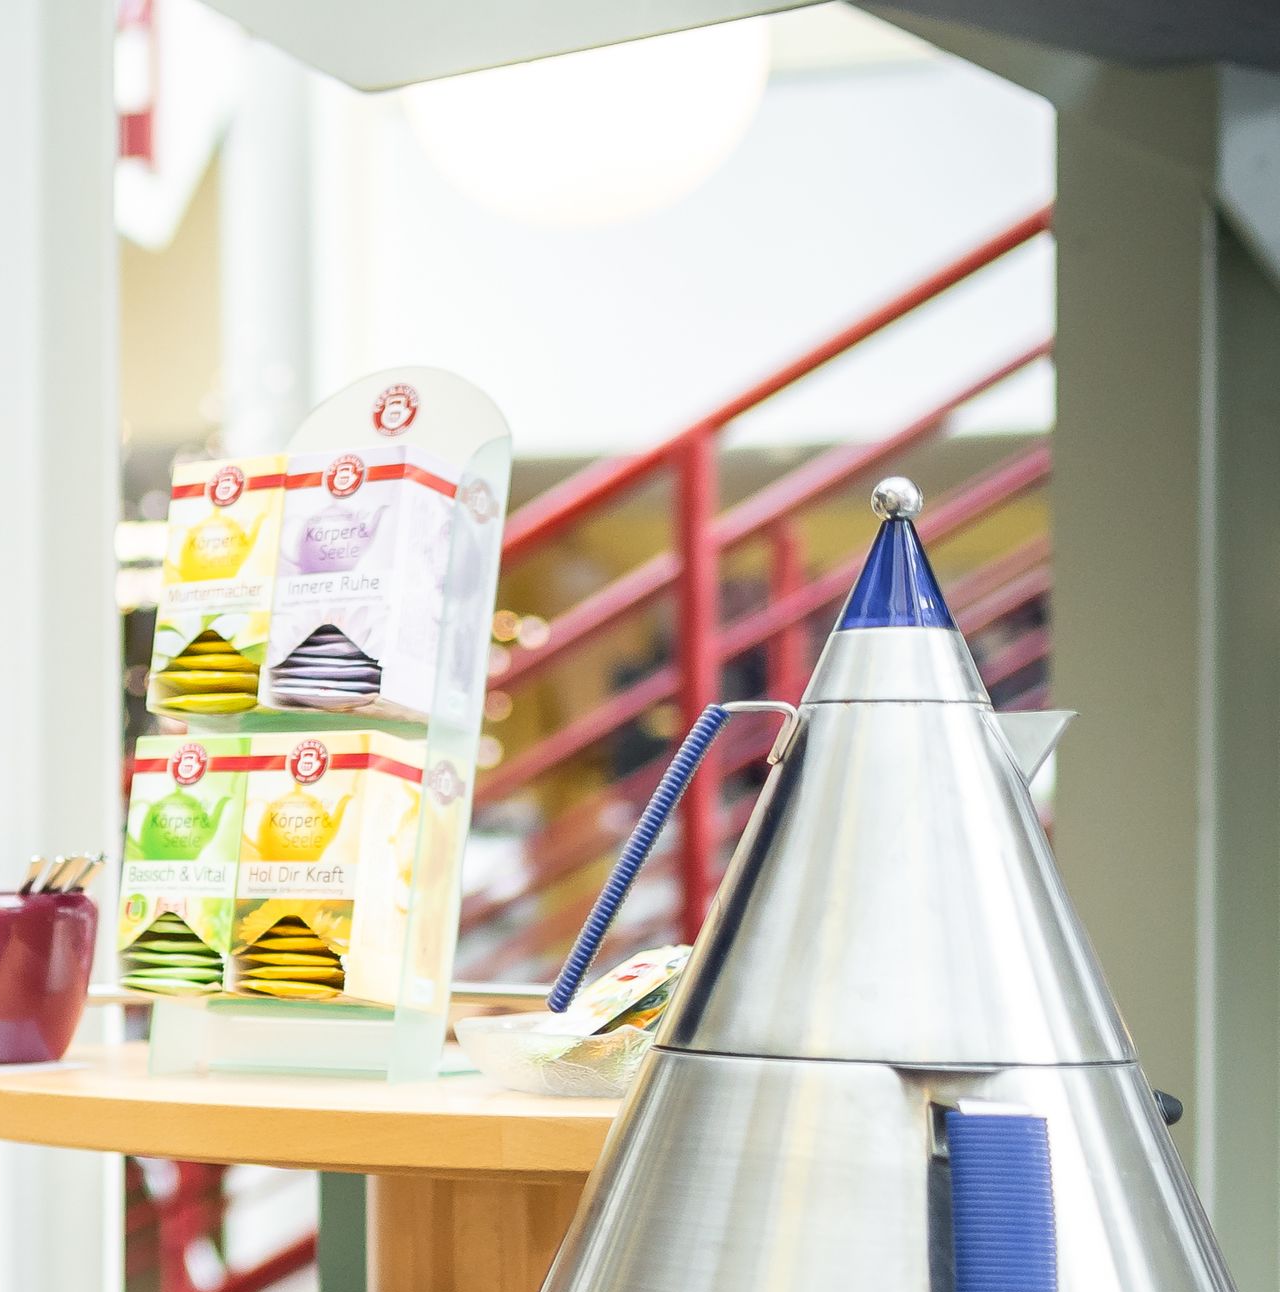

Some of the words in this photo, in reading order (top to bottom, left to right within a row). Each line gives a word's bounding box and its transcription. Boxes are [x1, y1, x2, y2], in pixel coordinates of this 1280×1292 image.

[318, 542, 361, 561] Seele
[168, 582, 263, 603] Muntermacher
[288, 579, 334, 596] Innere
[340, 575, 380, 592] Ruhe
[163, 831, 201, 848] Seele
[281, 831, 323, 848] Seele
[128, 865, 176, 883] Basisch
[180, 866, 190, 882] &
[194, 865, 226, 883] Vital
[248, 866, 272, 884] Hol
[278, 866, 297, 883] Dir
[306, 865, 345, 884] Kraft
